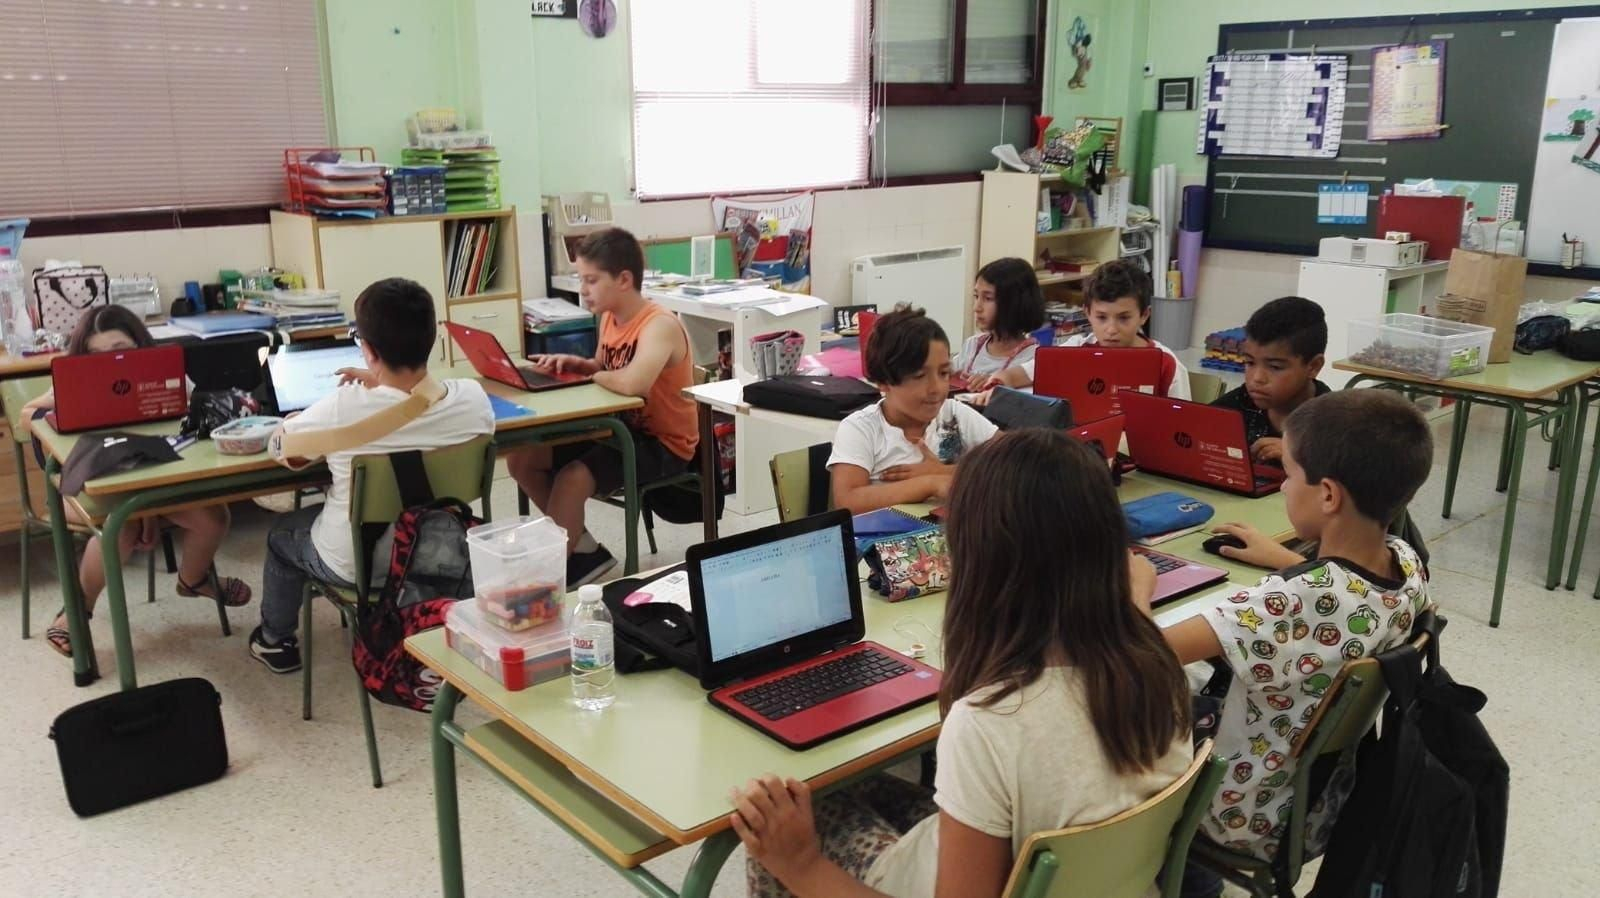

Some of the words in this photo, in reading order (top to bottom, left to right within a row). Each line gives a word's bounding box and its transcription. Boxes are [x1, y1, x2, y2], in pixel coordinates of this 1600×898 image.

[114, 380, 130, 395] hp
[1089, 378, 1104, 394] hp
[1176, 432, 1191, 448] hp
